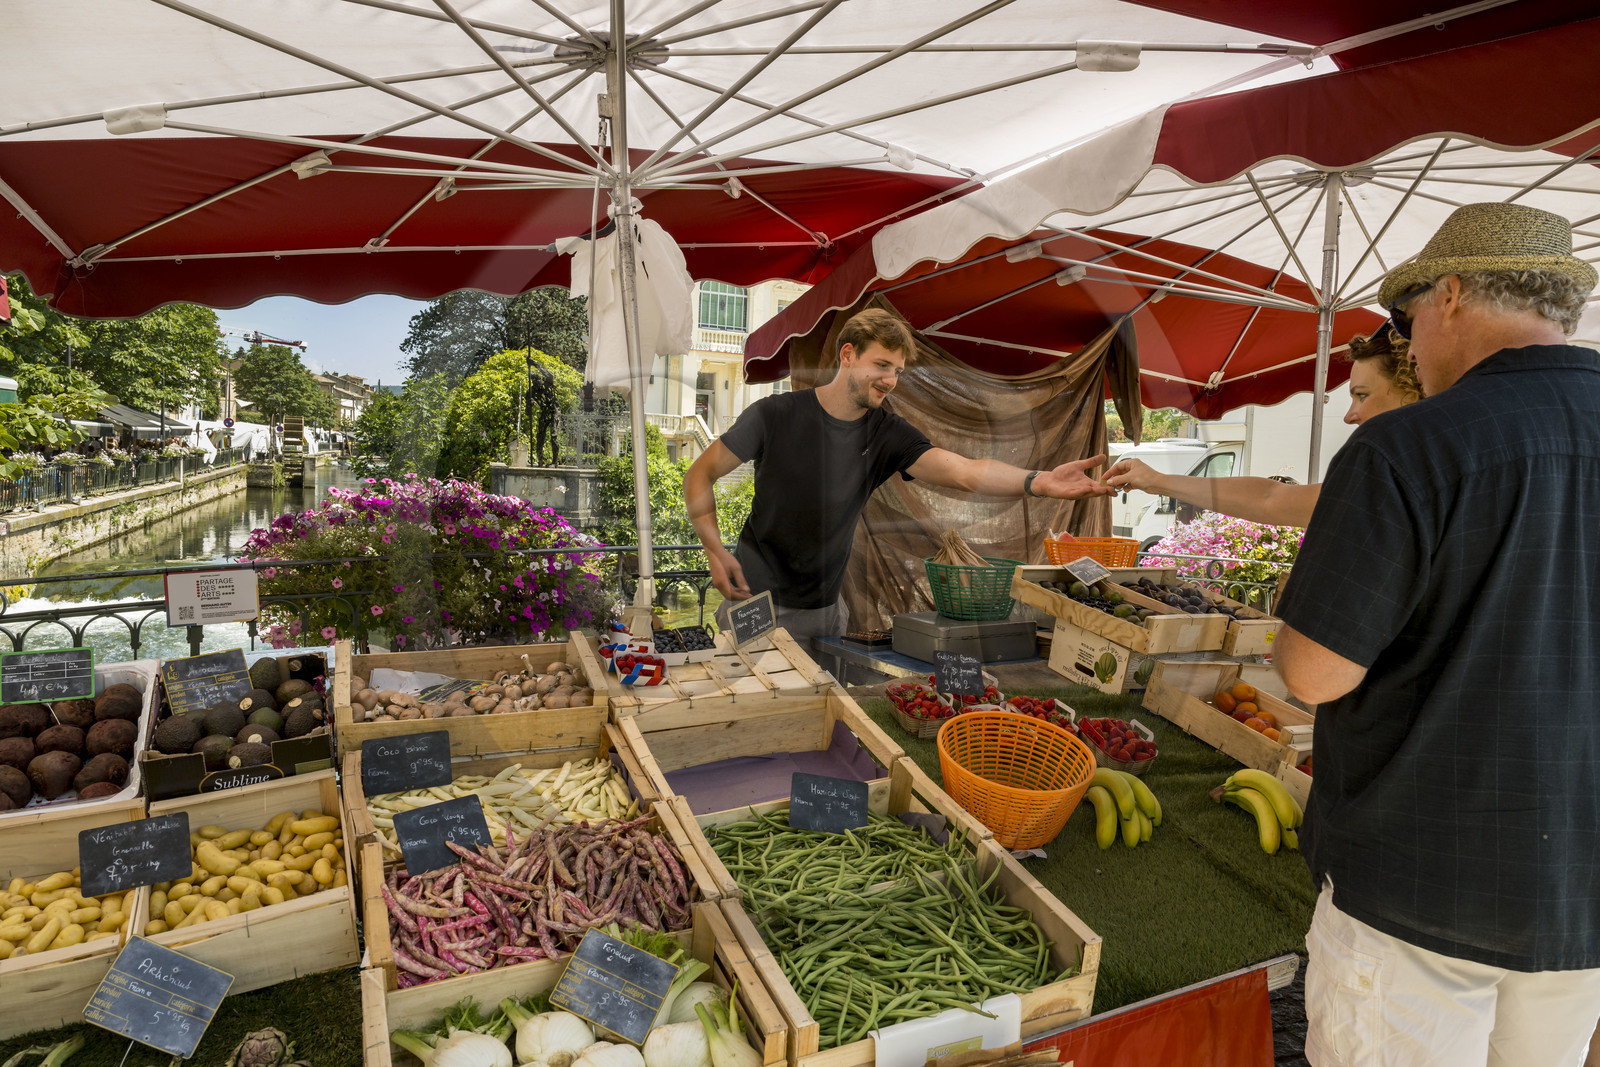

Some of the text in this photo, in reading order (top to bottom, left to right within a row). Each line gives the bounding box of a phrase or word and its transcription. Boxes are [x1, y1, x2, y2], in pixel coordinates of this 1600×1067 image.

[213, 774, 270, 791] Sublime
[108, 972, 129, 986] origine
[563, 971, 583, 984] produit
[100, 985, 122, 999] produit
[624, 986, 647, 1000] catégorie
[93, 997, 113, 1010] variété
[171, 998, 196, 1013] catégorie
[552, 993, 570, 1006] calibre
[85, 1009, 106, 1023] calibre
